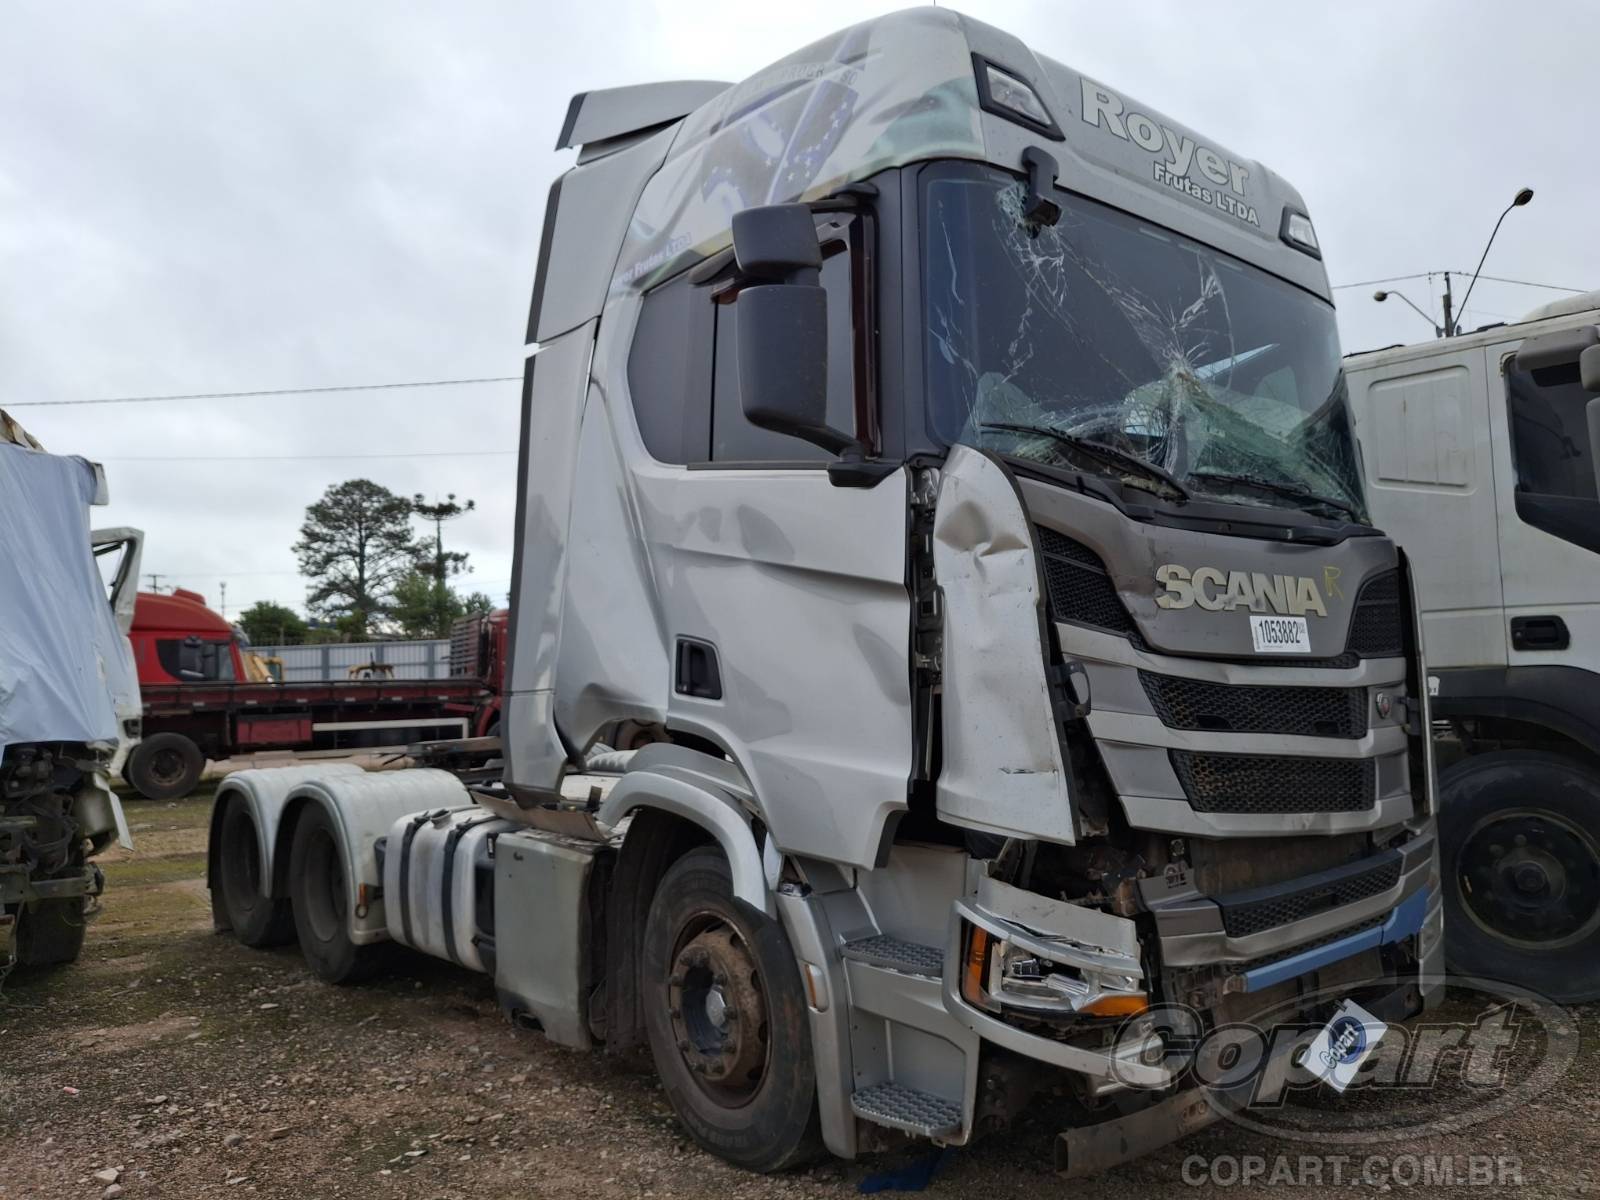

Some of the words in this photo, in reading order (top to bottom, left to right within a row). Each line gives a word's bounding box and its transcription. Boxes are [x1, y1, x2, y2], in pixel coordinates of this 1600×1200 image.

[1080, 78, 1249, 197] Royer
[1153, 161, 1212, 204] Frutas
[1215, 191, 1260, 227] LTDA
[1155, 564, 1328, 617] SCANIA
[1324, 566, 1344, 599] R
[1258, 619, 1301, 644] 1053882
[1318, 1021, 1360, 1070] Copart
